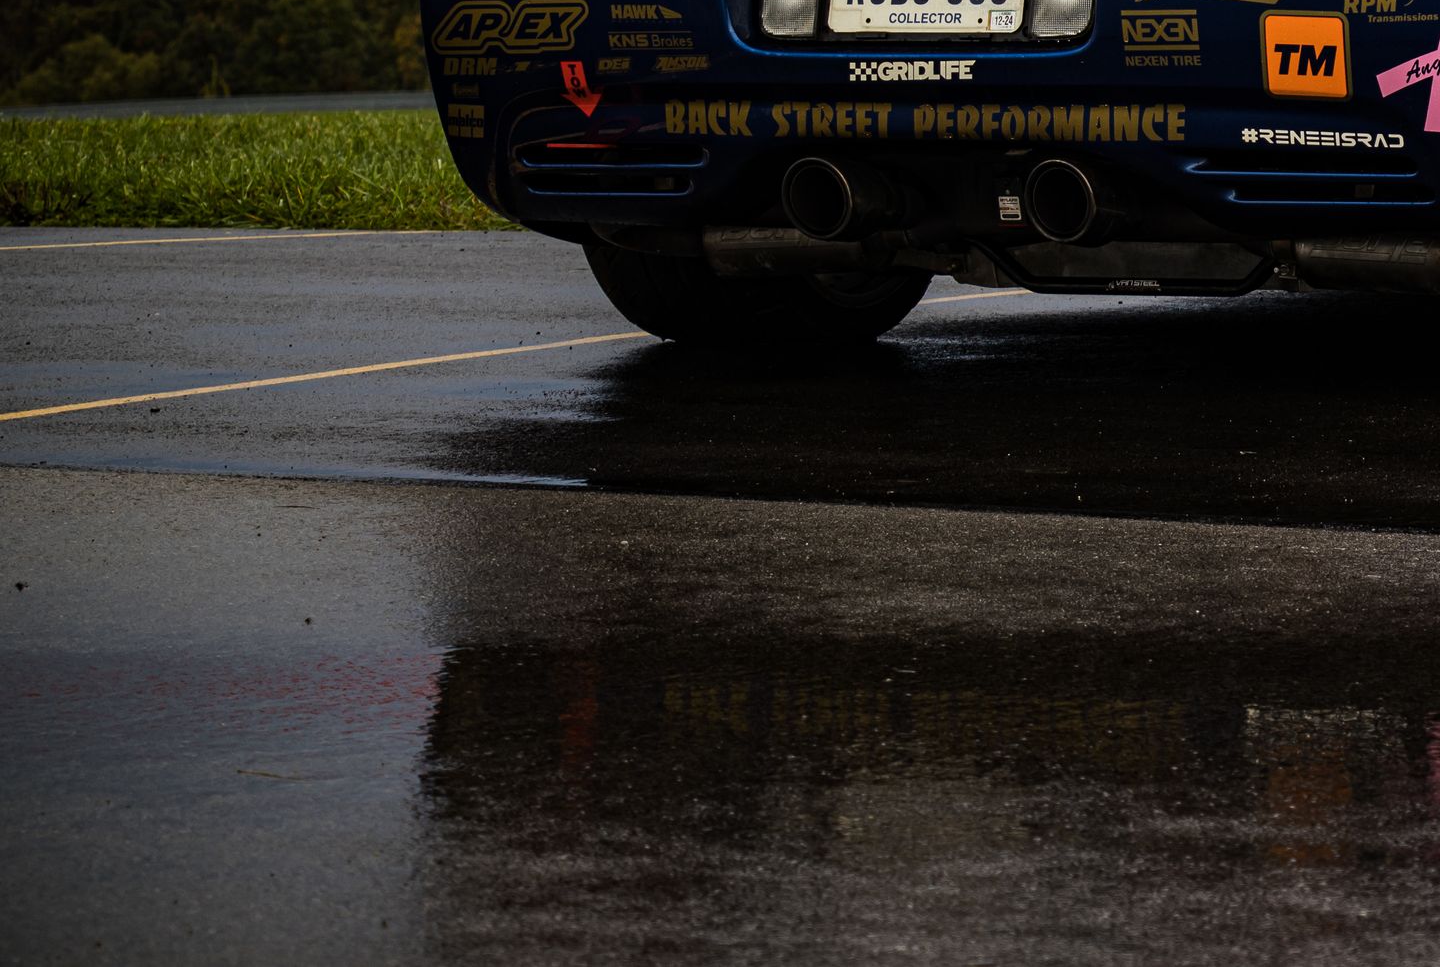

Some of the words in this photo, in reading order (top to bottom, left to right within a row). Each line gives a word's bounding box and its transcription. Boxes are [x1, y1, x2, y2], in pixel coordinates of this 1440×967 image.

[610, 4, 659, 20] HAWK
[889, 12, 962, 24] COLLECTOR
[994, 15, 1014, 25] 12-24
[1367, 12, 1439, 24] Transmissions
[1121, 15, 1199, 43] NEXEN
[608, 34, 650, 48] KNS
[652, 34, 695, 48] Brakes
[1125, 55, 1169, 67] NEXEN
[1171, 55, 1202, 67] TIRE
[1274, 44, 1338, 77] TM
[877, 60, 976, 81] GRIDLIFE
[567, 64, 588, 98] TOW
[665, 99, 752, 137] BACK
[771, 100, 892, 139] STREET
[913, 102, 1185, 142] PERFORMANCE
[1241, 127, 1406, 150] #RENEEISRAD
